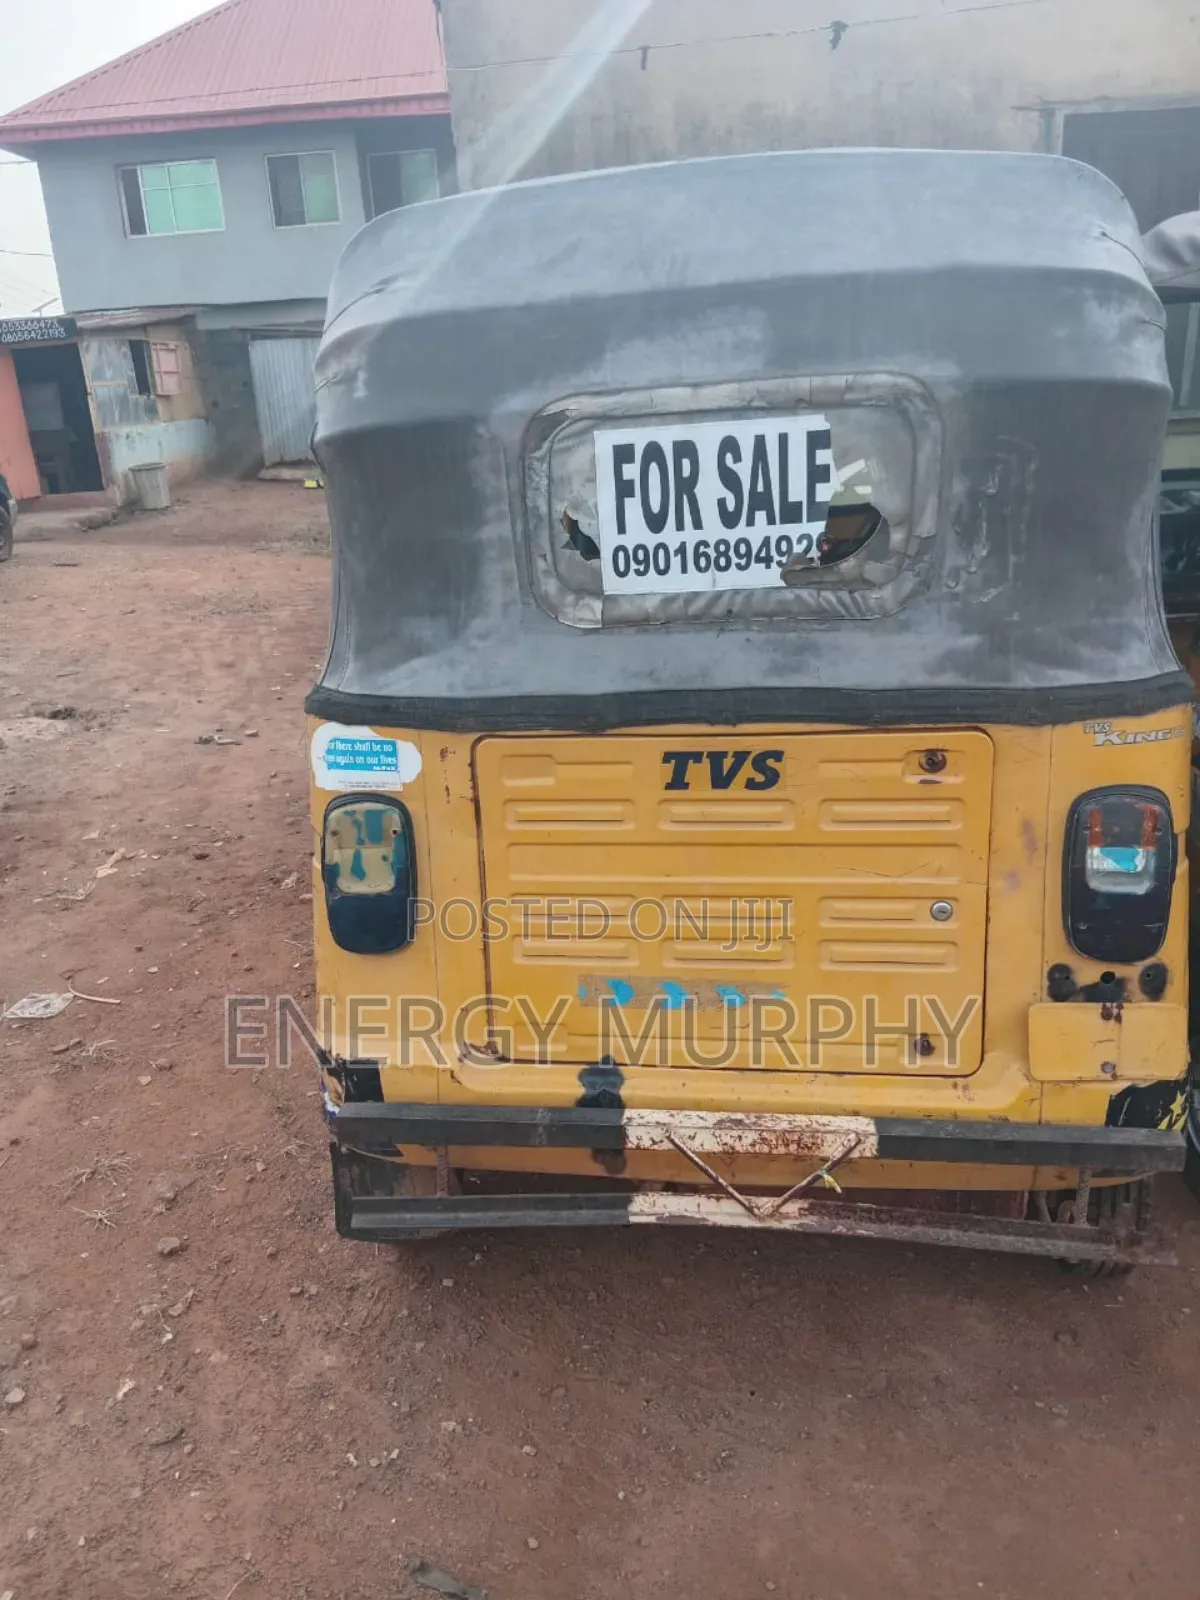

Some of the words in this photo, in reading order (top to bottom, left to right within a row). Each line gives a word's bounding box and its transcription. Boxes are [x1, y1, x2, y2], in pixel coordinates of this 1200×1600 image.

[612, 439, 704, 535] FOR
[717, 429, 831, 530] SALE
[1083, 722, 1112, 735] TVS
[354, 741, 371, 751] shall
[372, 741, 382, 752] be
[383, 744, 394, 752] no
[355, 756, 365, 764] on
[365, 756, 379, 765] our
[379, 755, 397, 765] lives
[662, 750, 785, 791] TVS
